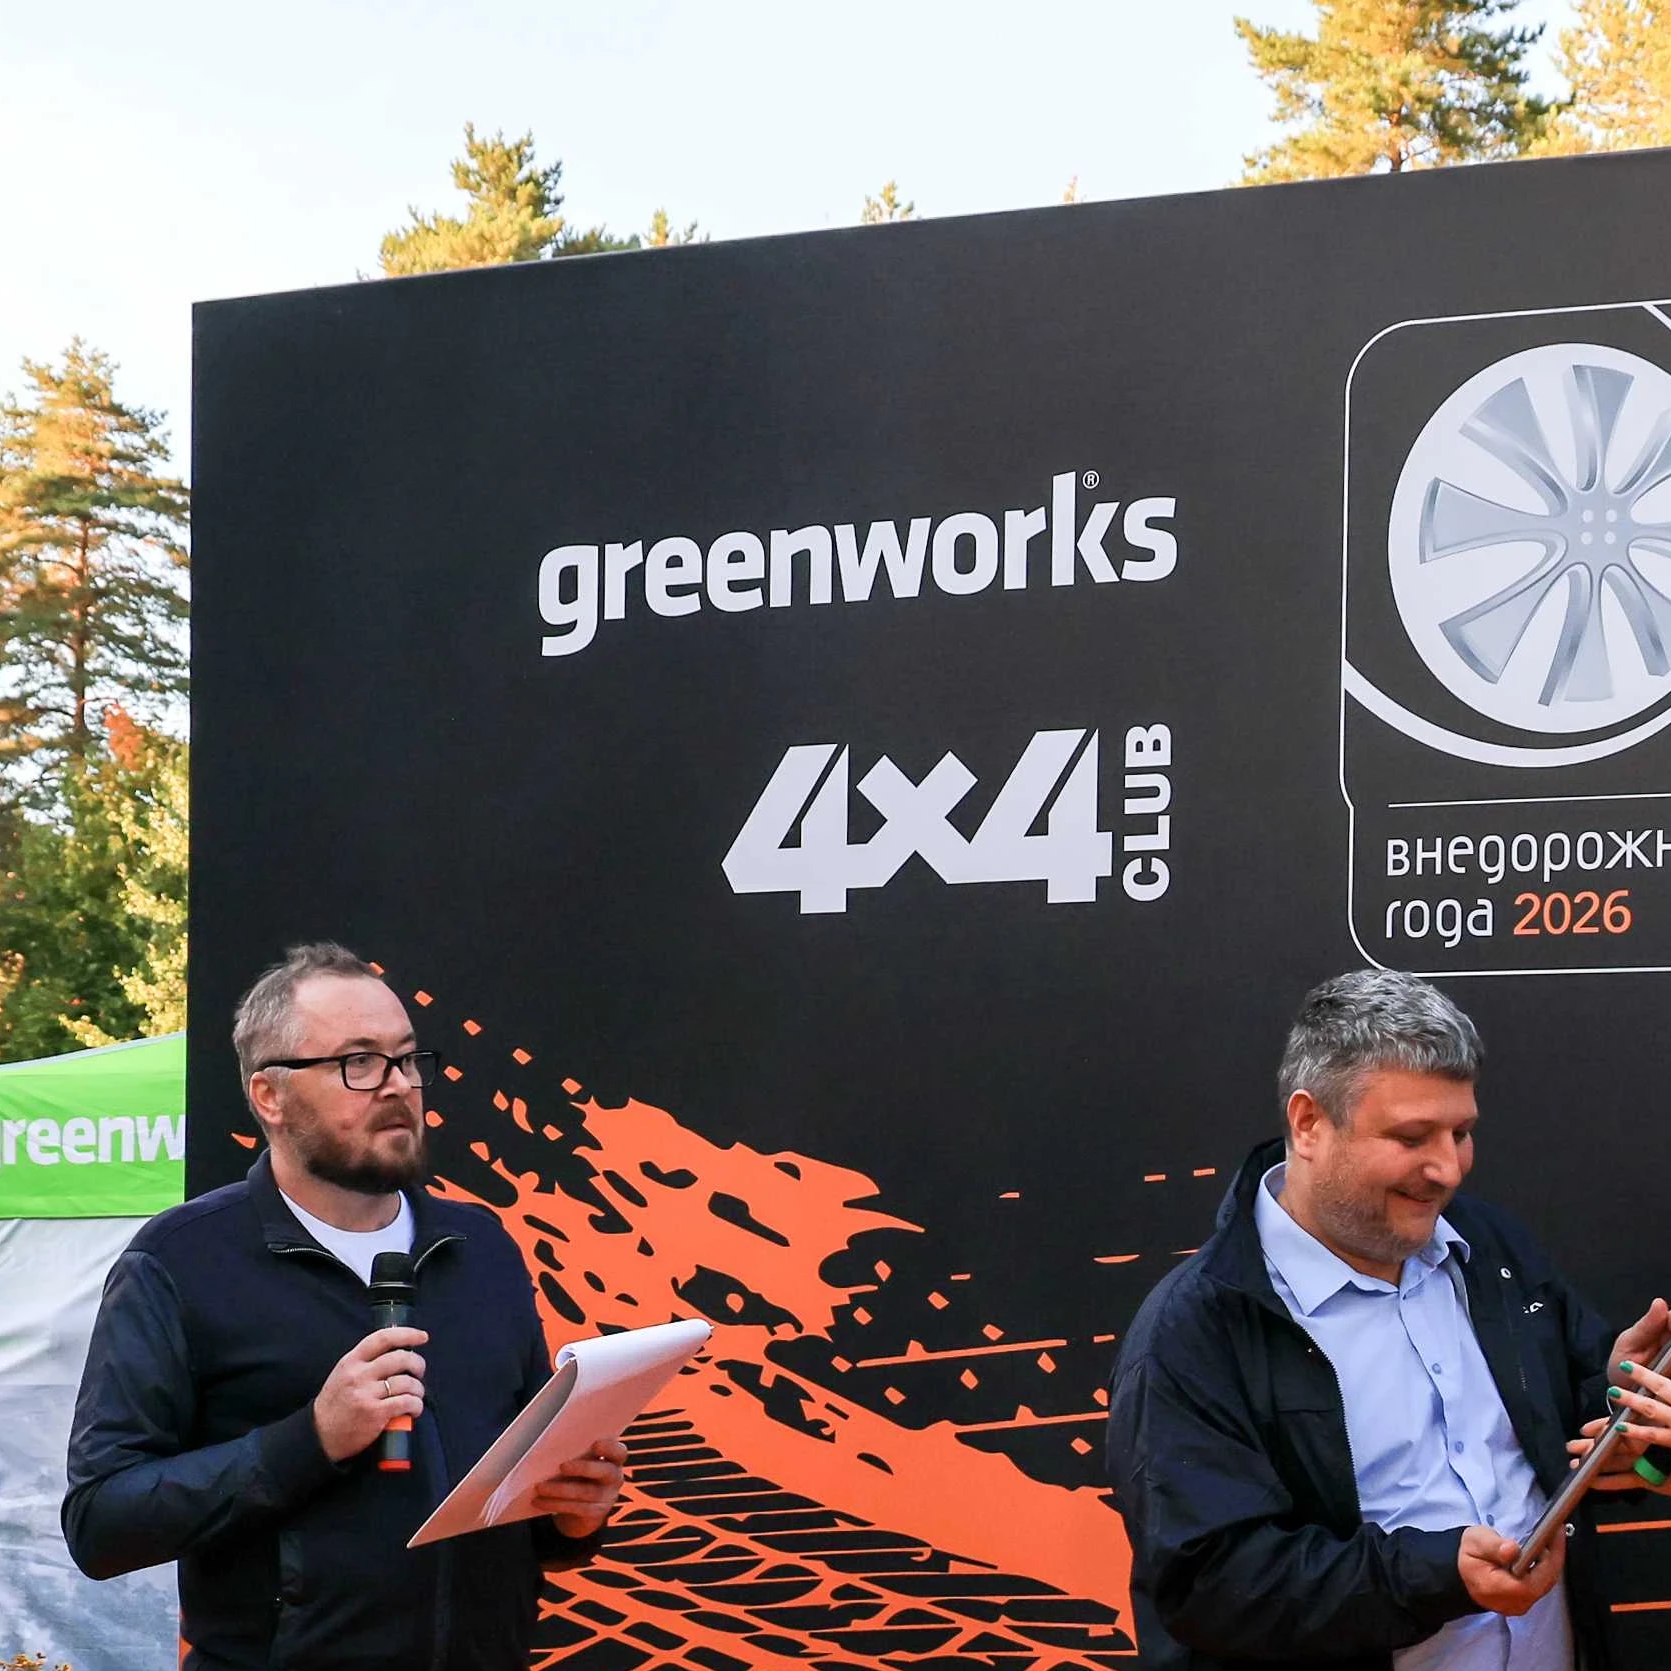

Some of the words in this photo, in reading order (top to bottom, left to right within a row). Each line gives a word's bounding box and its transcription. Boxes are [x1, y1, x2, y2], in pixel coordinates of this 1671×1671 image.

[537, 470, 1178, 657] greenworks
[720, 727, 1113, 915] 4x4
[1122, 722, 1173, 903] CLUB
[1384, 896, 1495, 948] года
[1512, 889, 1633, 936] 2026
